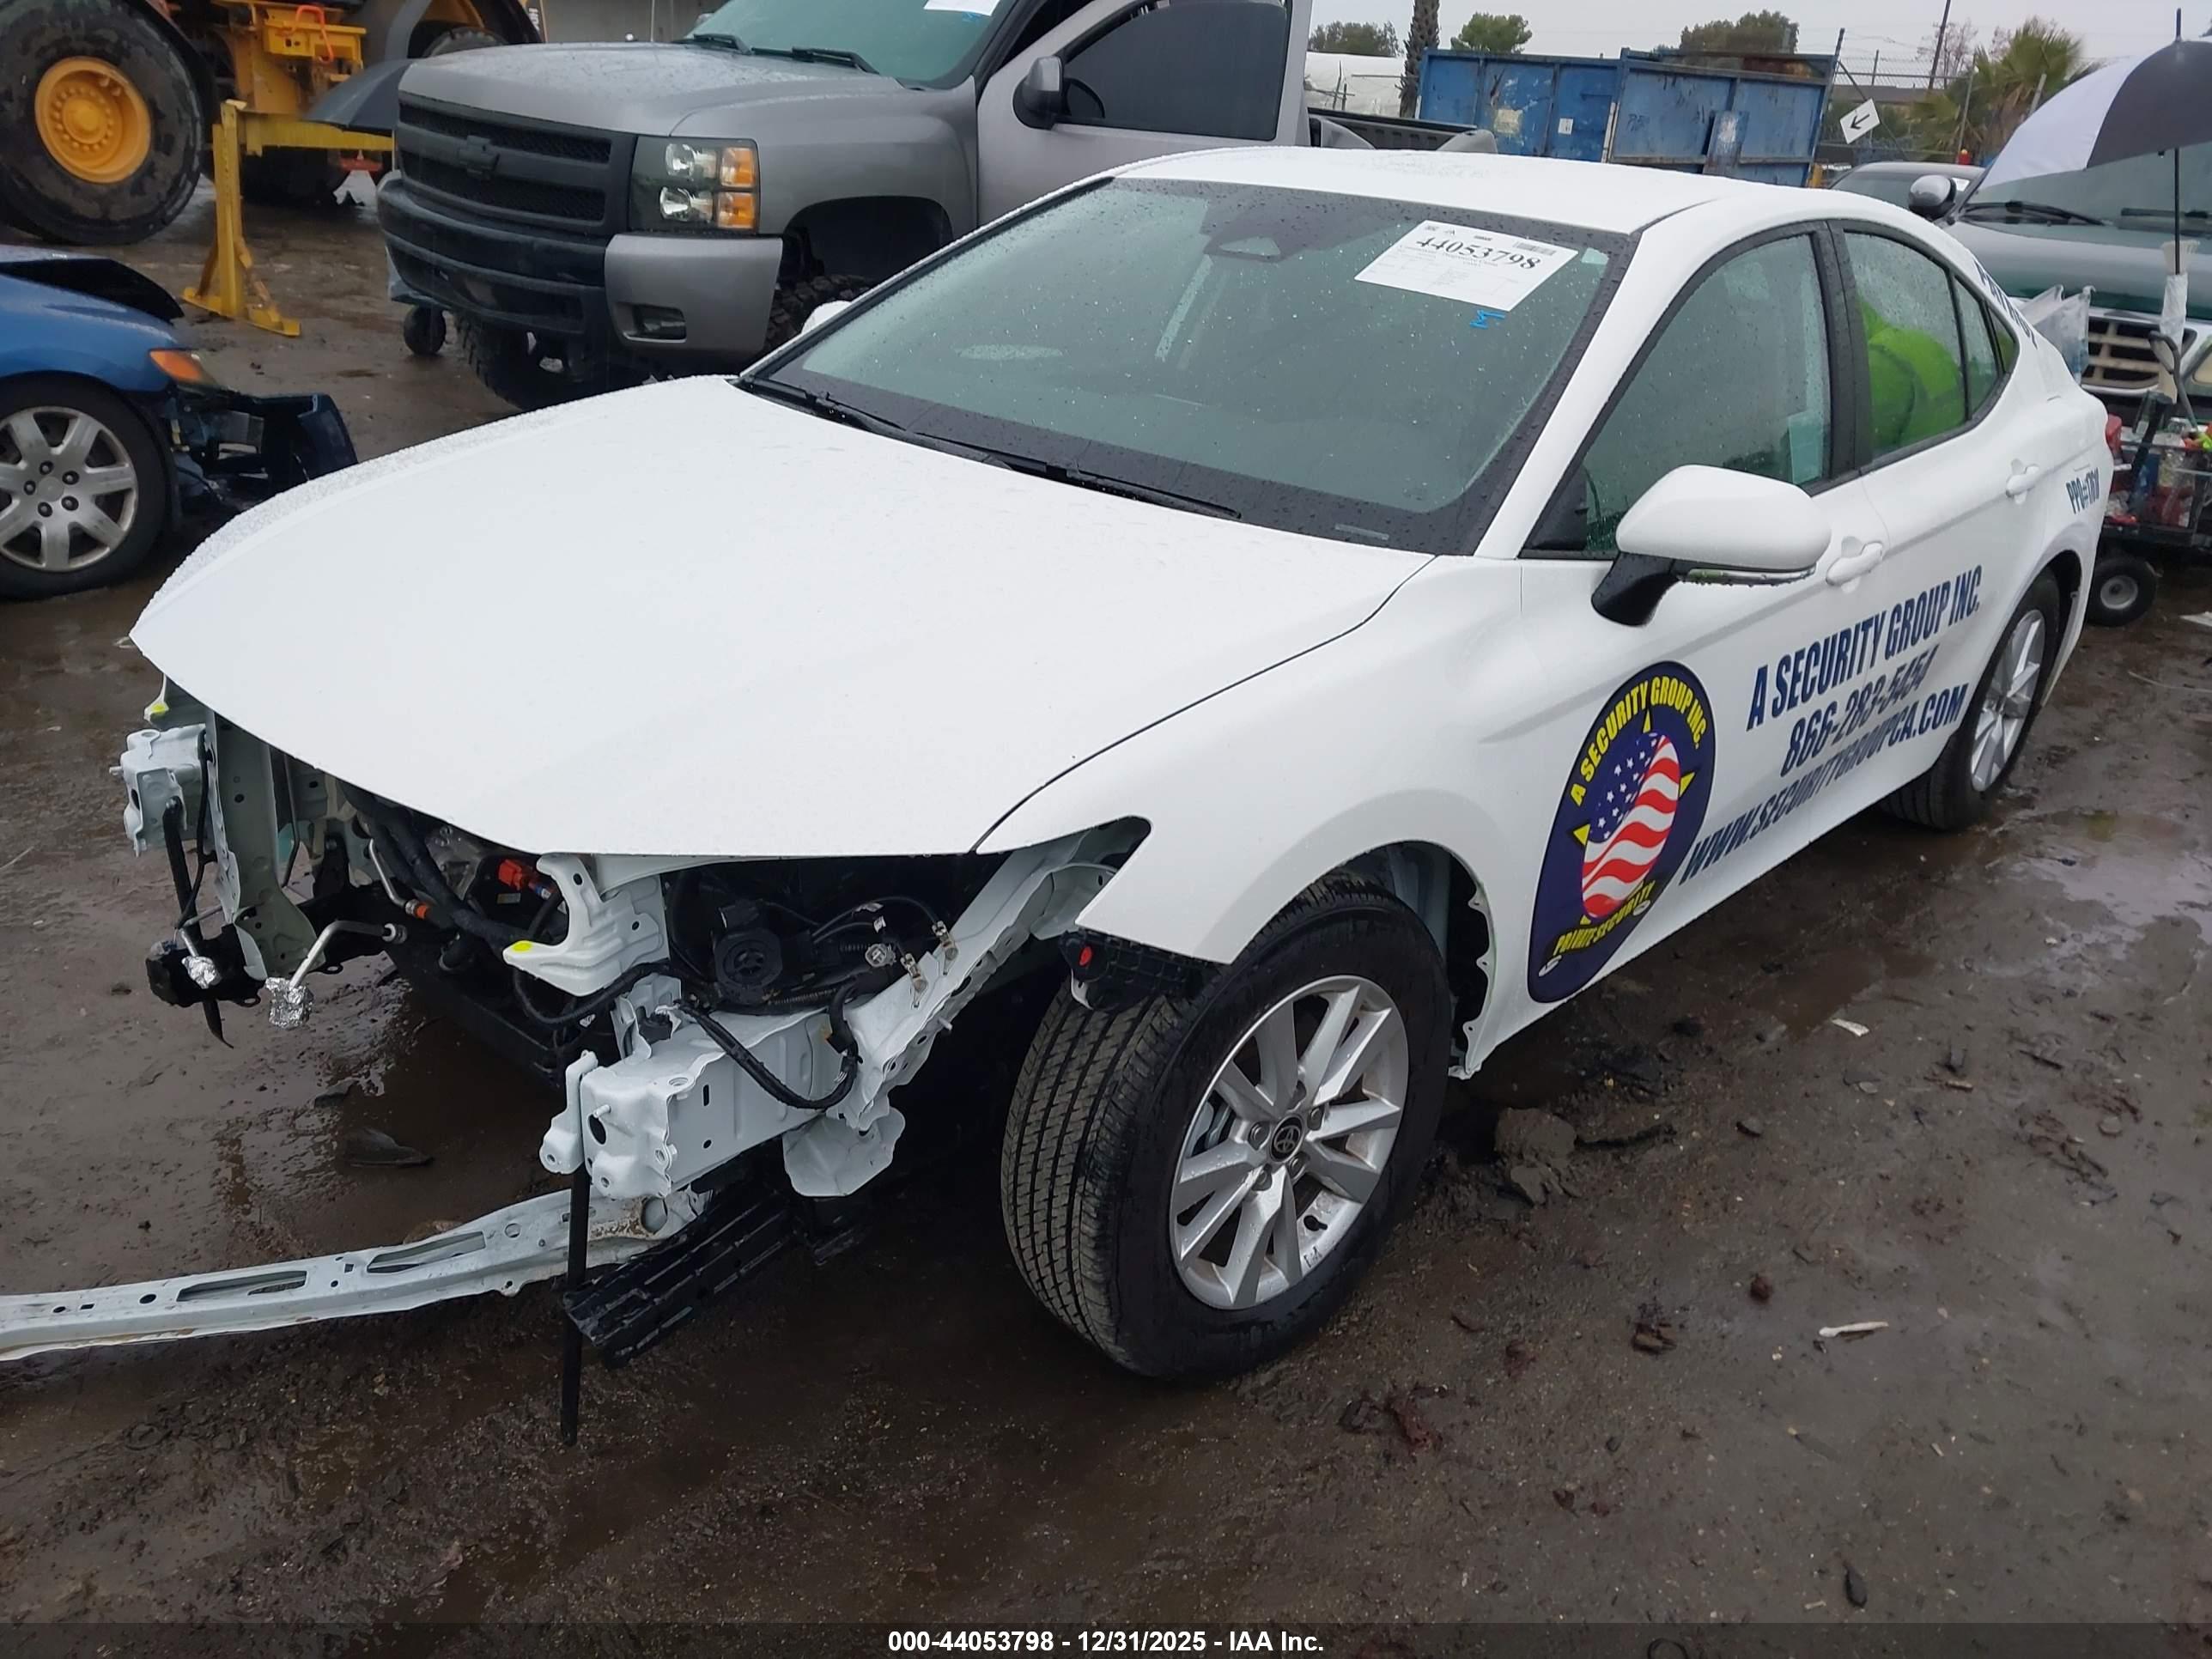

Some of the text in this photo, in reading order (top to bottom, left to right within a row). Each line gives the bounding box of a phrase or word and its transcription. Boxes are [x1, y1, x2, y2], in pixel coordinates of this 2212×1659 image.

[1416, 236, 1542, 270] 44053798
[1746, 664, 1769, 732] A
[1771, 610, 1887, 720] SECURITY
[1884, 580, 1952, 661] GROUP
[1570, 676, 1707, 807] A SECURITY GROUP INC.
